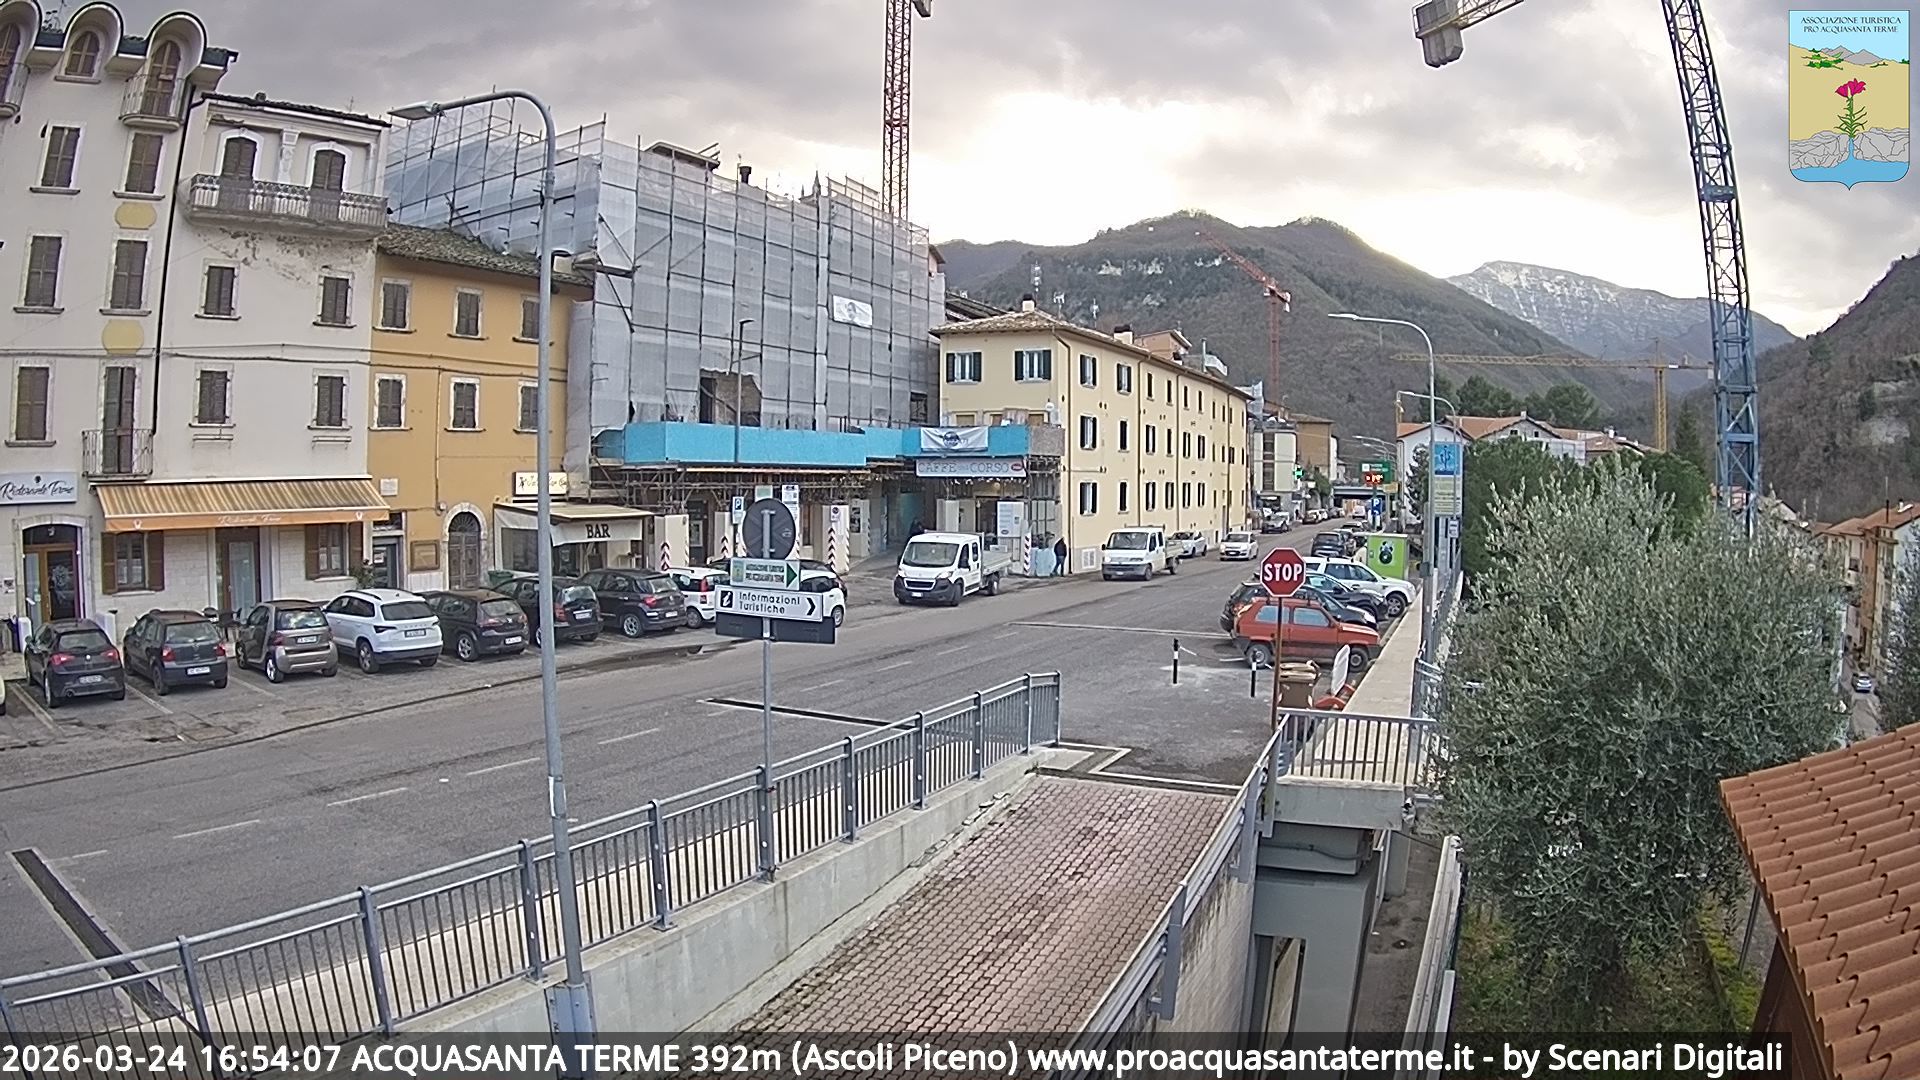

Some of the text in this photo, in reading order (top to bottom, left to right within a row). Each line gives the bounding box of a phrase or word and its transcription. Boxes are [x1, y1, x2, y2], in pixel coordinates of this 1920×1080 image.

[969, 462, 1009, 473] CORSO
[585, 523, 611, 539] BAR
[1263, 563, 1303, 582] STOP
[739, 591, 801, 605] Informazioni
[739, 601, 785, 614] Turistiche
